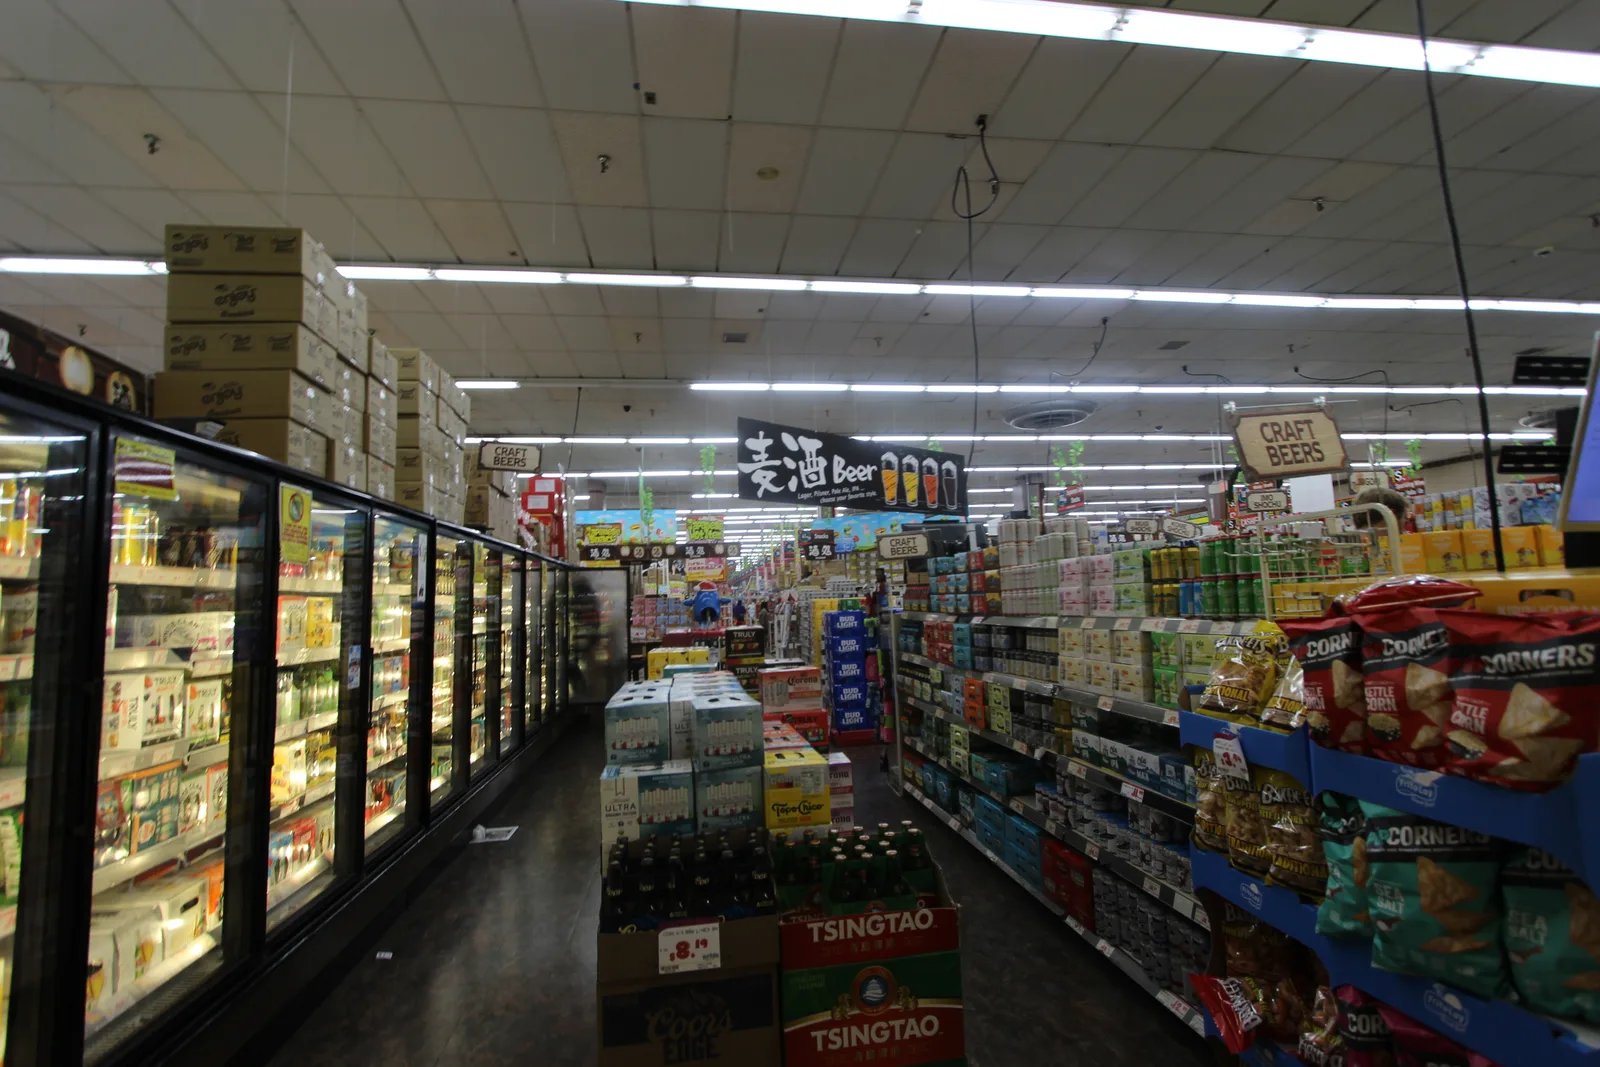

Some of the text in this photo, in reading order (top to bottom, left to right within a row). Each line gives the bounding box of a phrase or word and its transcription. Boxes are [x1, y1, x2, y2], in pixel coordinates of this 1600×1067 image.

[1260, 419, 1316, 443] CRAFT
[494, 446, 528, 458] CRAFT
[1265, 441, 1325, 466] BEERS
[493, 456, 527, 468] BEERS
[738, 430, 828, 498] 麦酒
[833, 453, 878, 485] Beer
[820, 496, 836, 504] choose
[1254, 501, 1282, 509] SHOCHU
[890, 537, 917, 547] CRAFT
[890, 545, 918, 556] BEERS
[838, 615, 856, 623] BUD
[836, 621, 858, 629] LIGHT
[732, 631, 757, 639] TRULY
[838, 644, 860, 653] LIGHT
[840, 639, 857, 647] BUD
[1479, 642, 1595, 675] CORNERS
[735, 666, 759, 675] TRULY
[839, 668, 861, 677] LIGHT
[841, 663, 858, 671] BUD
[787, 675, 819, 686] Corona
[840, 692, 862, 701] LIGHT
[842, 687, 859, 695] BUD
[1366, 697, 1399, 712] CORN
[844, 711, 861, 719] BUD
[842, 717, 864, 725] LIGHT
[605, 803, 637, 812] ULTRA
[771, 799, 825, 818] Topo Chico
[1372, 881, 1405, 902] SEA
[1377, 896, 1405, 915] SALT
[1506, 908, 1548, 930] SEA
[806, 908, 934, 943] TSINGTAO
[1507, 925, 1548, 946] SALT
[644, 1006, 734, 1044] Coors
[810, 1015, 940, 1053] TSINGTAO
